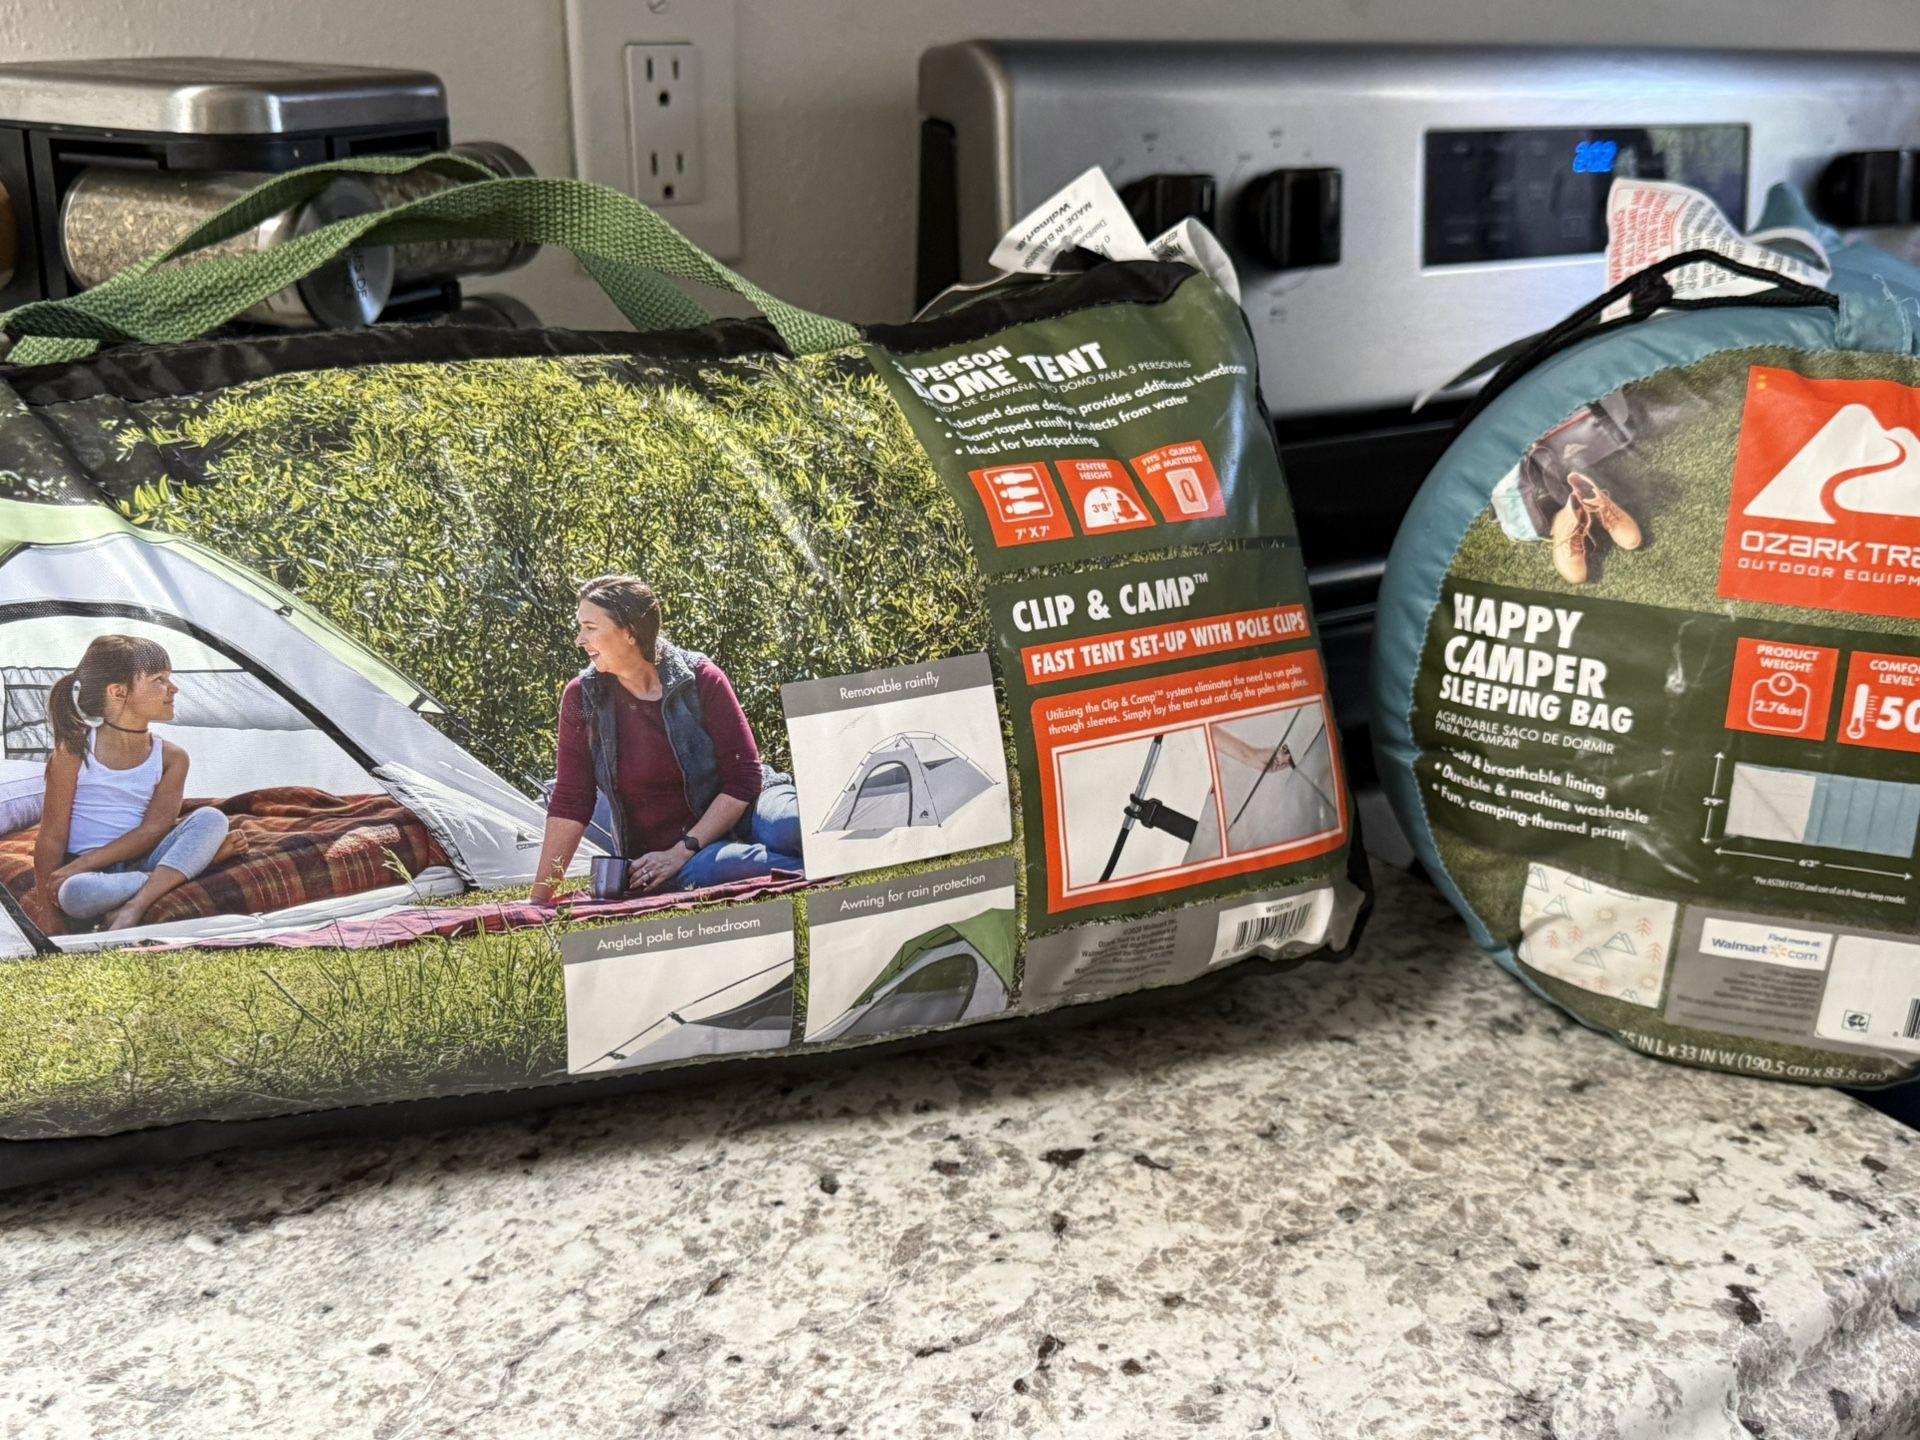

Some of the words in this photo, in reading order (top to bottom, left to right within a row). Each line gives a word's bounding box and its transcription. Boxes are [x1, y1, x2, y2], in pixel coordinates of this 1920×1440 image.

[1054, 223, 1066, 236] IN
[1065, 201, 1092, 227] MADE
[1017, 341, 1108, 383] TENT
[945, 408, 1002, 430] nlarged
[1004, 402, 1041, 417] dome
[1042, 398, 1077, 416] design
[1078, 395, 1132, 417] provides
[1134, 377, 1195, 399] additional
[1193, 362, 1247, 385] headroom
[962, 398, 979, 408] DE
[980, 382, 1038, 402] CAMPAÑA
[1060, 376, 1097, 393] DOMO
[1100, 369, 1127, 382] PARA
[1128, 365, 1137, 375] 3
[1138, 360, 1192, 372] PERSONAS
[1034, 416, 1073, 431] rainfly
[1074, 415, 1119, 431] protects
[1118, 405, 1151, 424] from
[1152, 395, 1188, 411] water
[965, 443, 1000, 456] Ideal
[1000, 439, 1021, 452] for
[1021, 433, 1099, 449] backpacking
[1141, 454, 1160, 466] FITS
[1168, 446, 1197, 458] QUEEN
[1075, 462, 1108, 471] CENTER
[1079, 470, 1113, 480] HEIGHT
[1146, 463, 1163, 474] AIR
[1163, 455, 1203, 469] MATTRESS
[1737, 557, 1835, 578] OUTDOOR
[1012, 593, 1075, 633] CLIP
[1087, 589, 1111, 621] &
[1453, 592, 1584, 649] HAPPY
[1031, 649, 1075, 677] FAST
[1080, 639, 1126, 668] TENT
[1131, 631, 1187, 659] SET-UP
[1190, 622, 1233, 648] WITH
[1237, 617, 1271, 641] POLE
[1273, 611, 1307, 635] CLIPS
[1757, 644, 1820, 661] PRODUCT
[1444, 635, 1608, 699] CAMPER
[1760, 657, 1815, 673] WEIGHT
[839, 677, 902, 701] Removable
[904, 671, 940, 690] rainfly
[1045, 707, 1083, 722] Utilizing
[1085, 703, 1100, 714] the
[1101, 698, 1119, 711] Clip
[1120, 696, 1129, 707] &
[1165, 686, 1193, 700] system
[1194, 679, 1232, 693] eliminates
[1233, 675, 1246, 686] the
[1246, 672, 1264, 684] need
[1264, 671, 1272, 680] to
[1272, 669, 1284, 679] run
[1285, 664, 1302, 678] poles
[1439, 673, 1561, 721] SLEEPING
[1569, 699, 1634, 734] BAG
[1048, 720, 1085, 736] through
[1086, 715, 1120, 729] sleeves.
[1122, 707, 1152, 722] Simply
[1153, 704, 1167, 718] lay
[1167, 702, 1181, 713] the
[1182, 698, 1198, 710] tent
[1200, 696, 1212, 706] out
[1214, 692, 1229, 703] and
[1230, 689, 1244, 702] clip
[1244, 686, 1256, 697] the
[1257, 683, 1275, 697] poles
[1275, 681, 1290, 691] into
[1434, 720, 1460, 737] PARA
[1462, 730, 1520, 750] ACAMPAR
[1435, 710, 1499, 735] AGRADABLE
[1502, 724, 1540, 742] SACO
[1542, 732, 1561, 746] DE
[1562, 735, 1615, 755] DORMIR
[1442, 764, 1492, 794] Durable
[1494, 783, 1507, 797] &
[1511, 786, 1571, 812] machine
[1574, 803, 1649, 825] washable
[1472, 754, 1482, 770] &
[1483, 758, 1562, 785] breathable
[1566, 773, 1607, 799] lining
[1440, 784, 1466, 808] Fun,
[1469, 798, 1587, 835] camping-themed
[1591, 824, 1627, 842] print
[839, 895, 885, 915] Awning
[887, 888, 905, 904] for
[906, 884, 931, 899] rain
[932, 871, 987, 897] protection
[597, 932, 643, 954] Angled
[645, 925, 675, 947] pole
[676, 923, 695, 940] for
[697, 917, 761, 937] headroom
[1711, 937, 1768, 954] Walmart
[1787, 949, 1819, 961] com
[1768, 933, 1788, 944] Find
[1788, 937, 1811, 947] more
[1637, 1034, 1656, 1051] IN
[1656, 1038, 1665, 1056] L
[1666, 1043, 1675, 1057] x
[1677, 1044, 1697, 1061] 33
[1699, 1047, 1717, 1065] IN
[1718, 1049, 1737, 1067] W
[1737, 1053, 1786, 1076] (190.5
[1786, 1065, 1809, 1078] cm
[1811, 1068, 1822, 1079] x
[1824, 1066, 1857, 1081] 83.8
[1858, 1068, 1888, 1082] cm)
